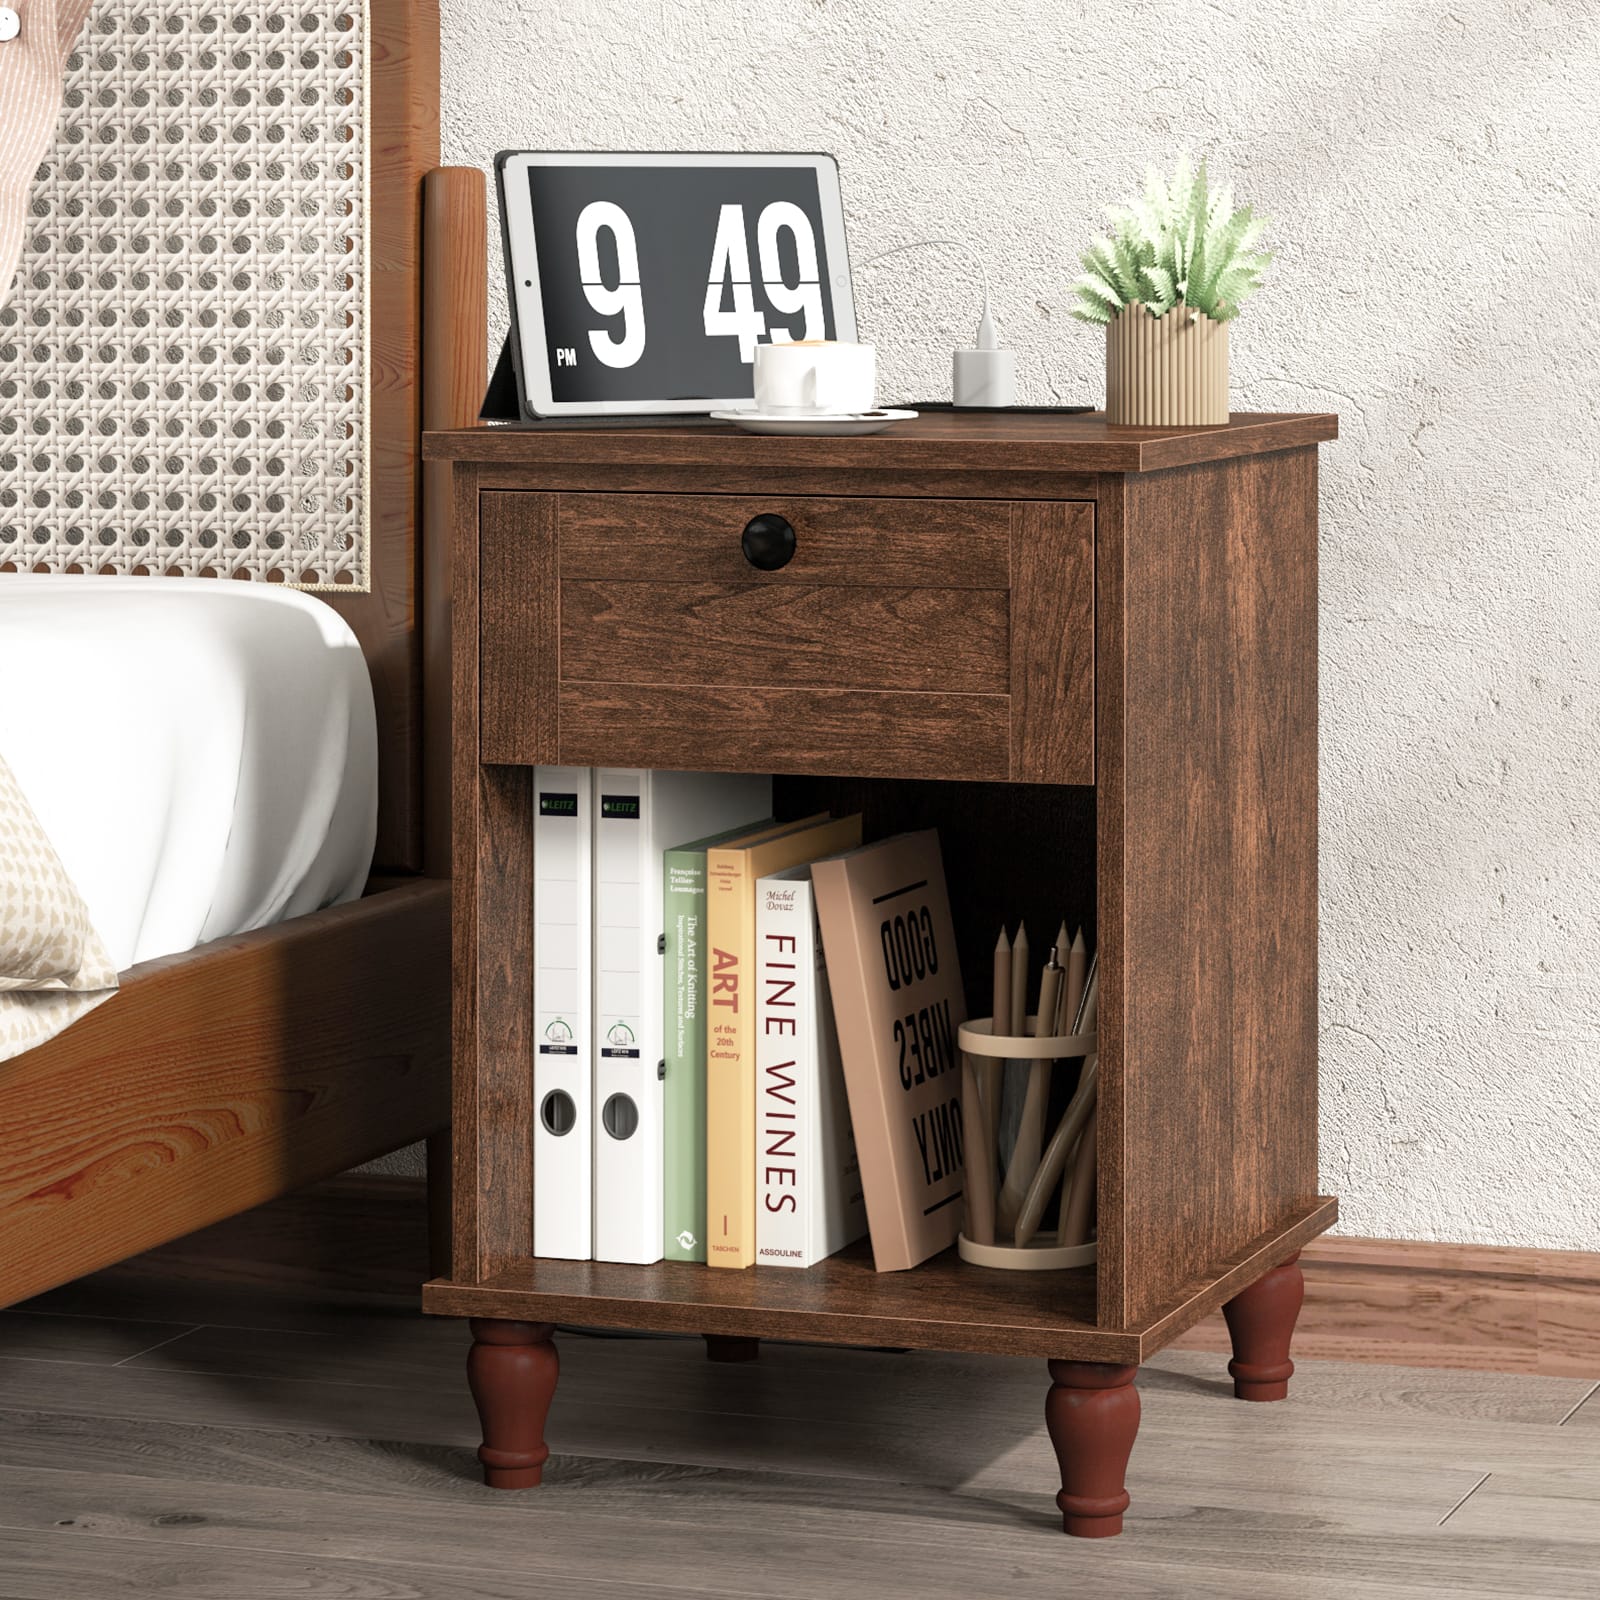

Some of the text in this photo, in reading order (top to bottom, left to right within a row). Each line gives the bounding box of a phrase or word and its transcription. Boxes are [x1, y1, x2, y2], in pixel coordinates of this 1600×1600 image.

[576, 200, 826, 369] 9 49
[556, 348, 577, 367] PM
[549, 801, 574, 809] LEITZ
[611, 803, 636, 812] LEITZ
[766, 890, 795, 902] Michel
[766, 900, 794, 912] Dovaz
[684, 915, 698, 1019] The Art of Knitting
[712, 948, 738, 1013] ART
[714, 1025, 737, 1034] of the
[716, 1038, 734, 1047] 20th
[710, 1050, 740, 1061] Century
[765, 934, 796, 1213] FINE WINES
[712, 1245, 739, 1253] TASCHEN
[759, 1248, 803, 1258] ASSOULINE
